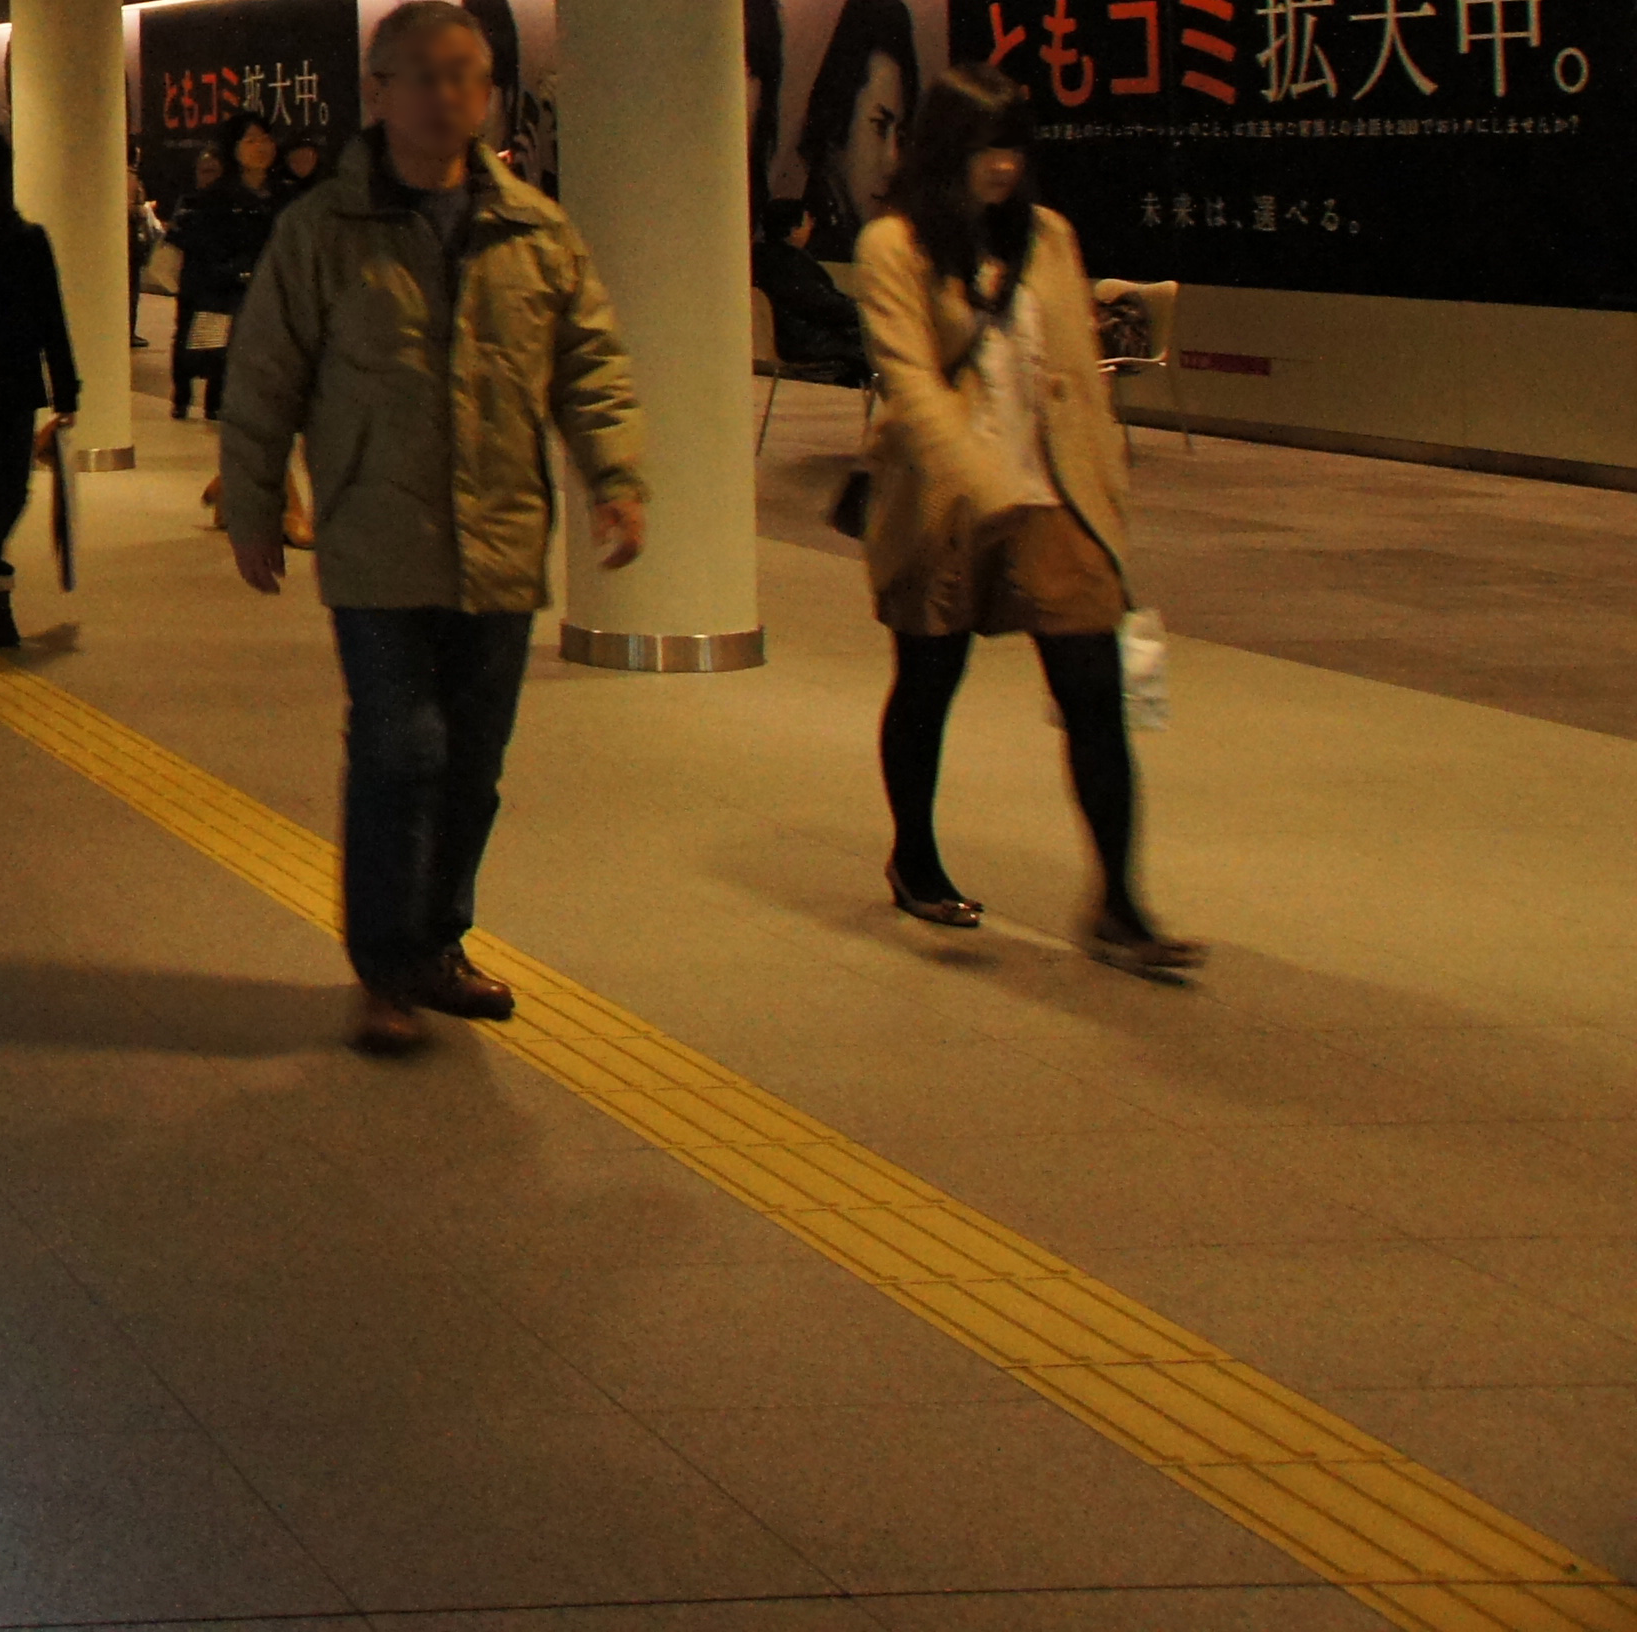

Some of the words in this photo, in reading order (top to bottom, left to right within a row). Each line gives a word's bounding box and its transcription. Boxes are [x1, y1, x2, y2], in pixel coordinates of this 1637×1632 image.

[1138, 191, 1362, 235] 未来は、選べる。
